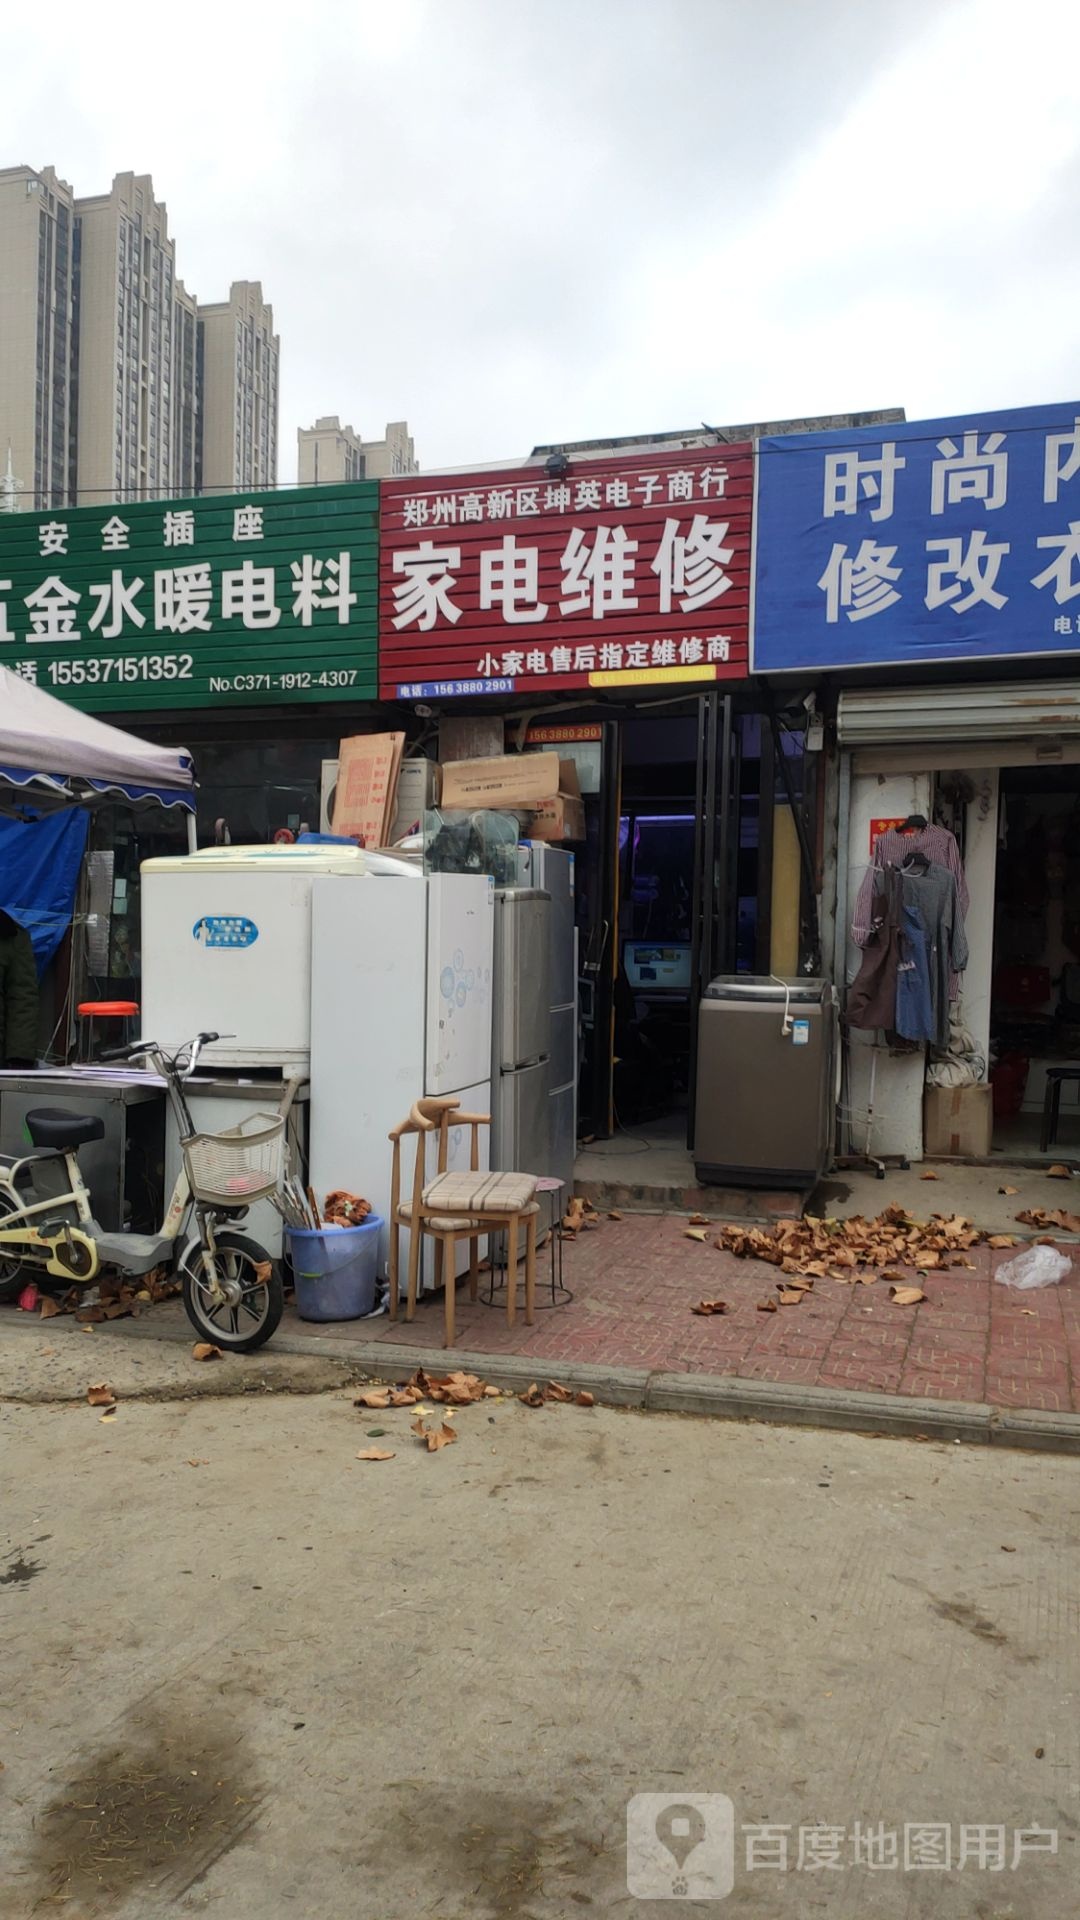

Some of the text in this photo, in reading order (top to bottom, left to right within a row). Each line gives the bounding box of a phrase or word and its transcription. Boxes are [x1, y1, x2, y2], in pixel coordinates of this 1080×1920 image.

[403, 466, 729, 527] 郑州高新区坤英电子商行
[38, 505, 264, 556] 安全插座
[391, 514, 735, 632] 家电维修
[0, 551, 357, 643] 金水暖电料
[1054, 614, 1080, 635] 电
[48, 654, 193, 686] 15537151352
[477, 634, 731, 677] 小家电售后指定维修商
[209, 670, 357, 692] No.C371-1912-4307
[434, 683, 454, 695] 156
[456, 681, 483, 693] 3880
[485, 679, 512, 691] 2901
